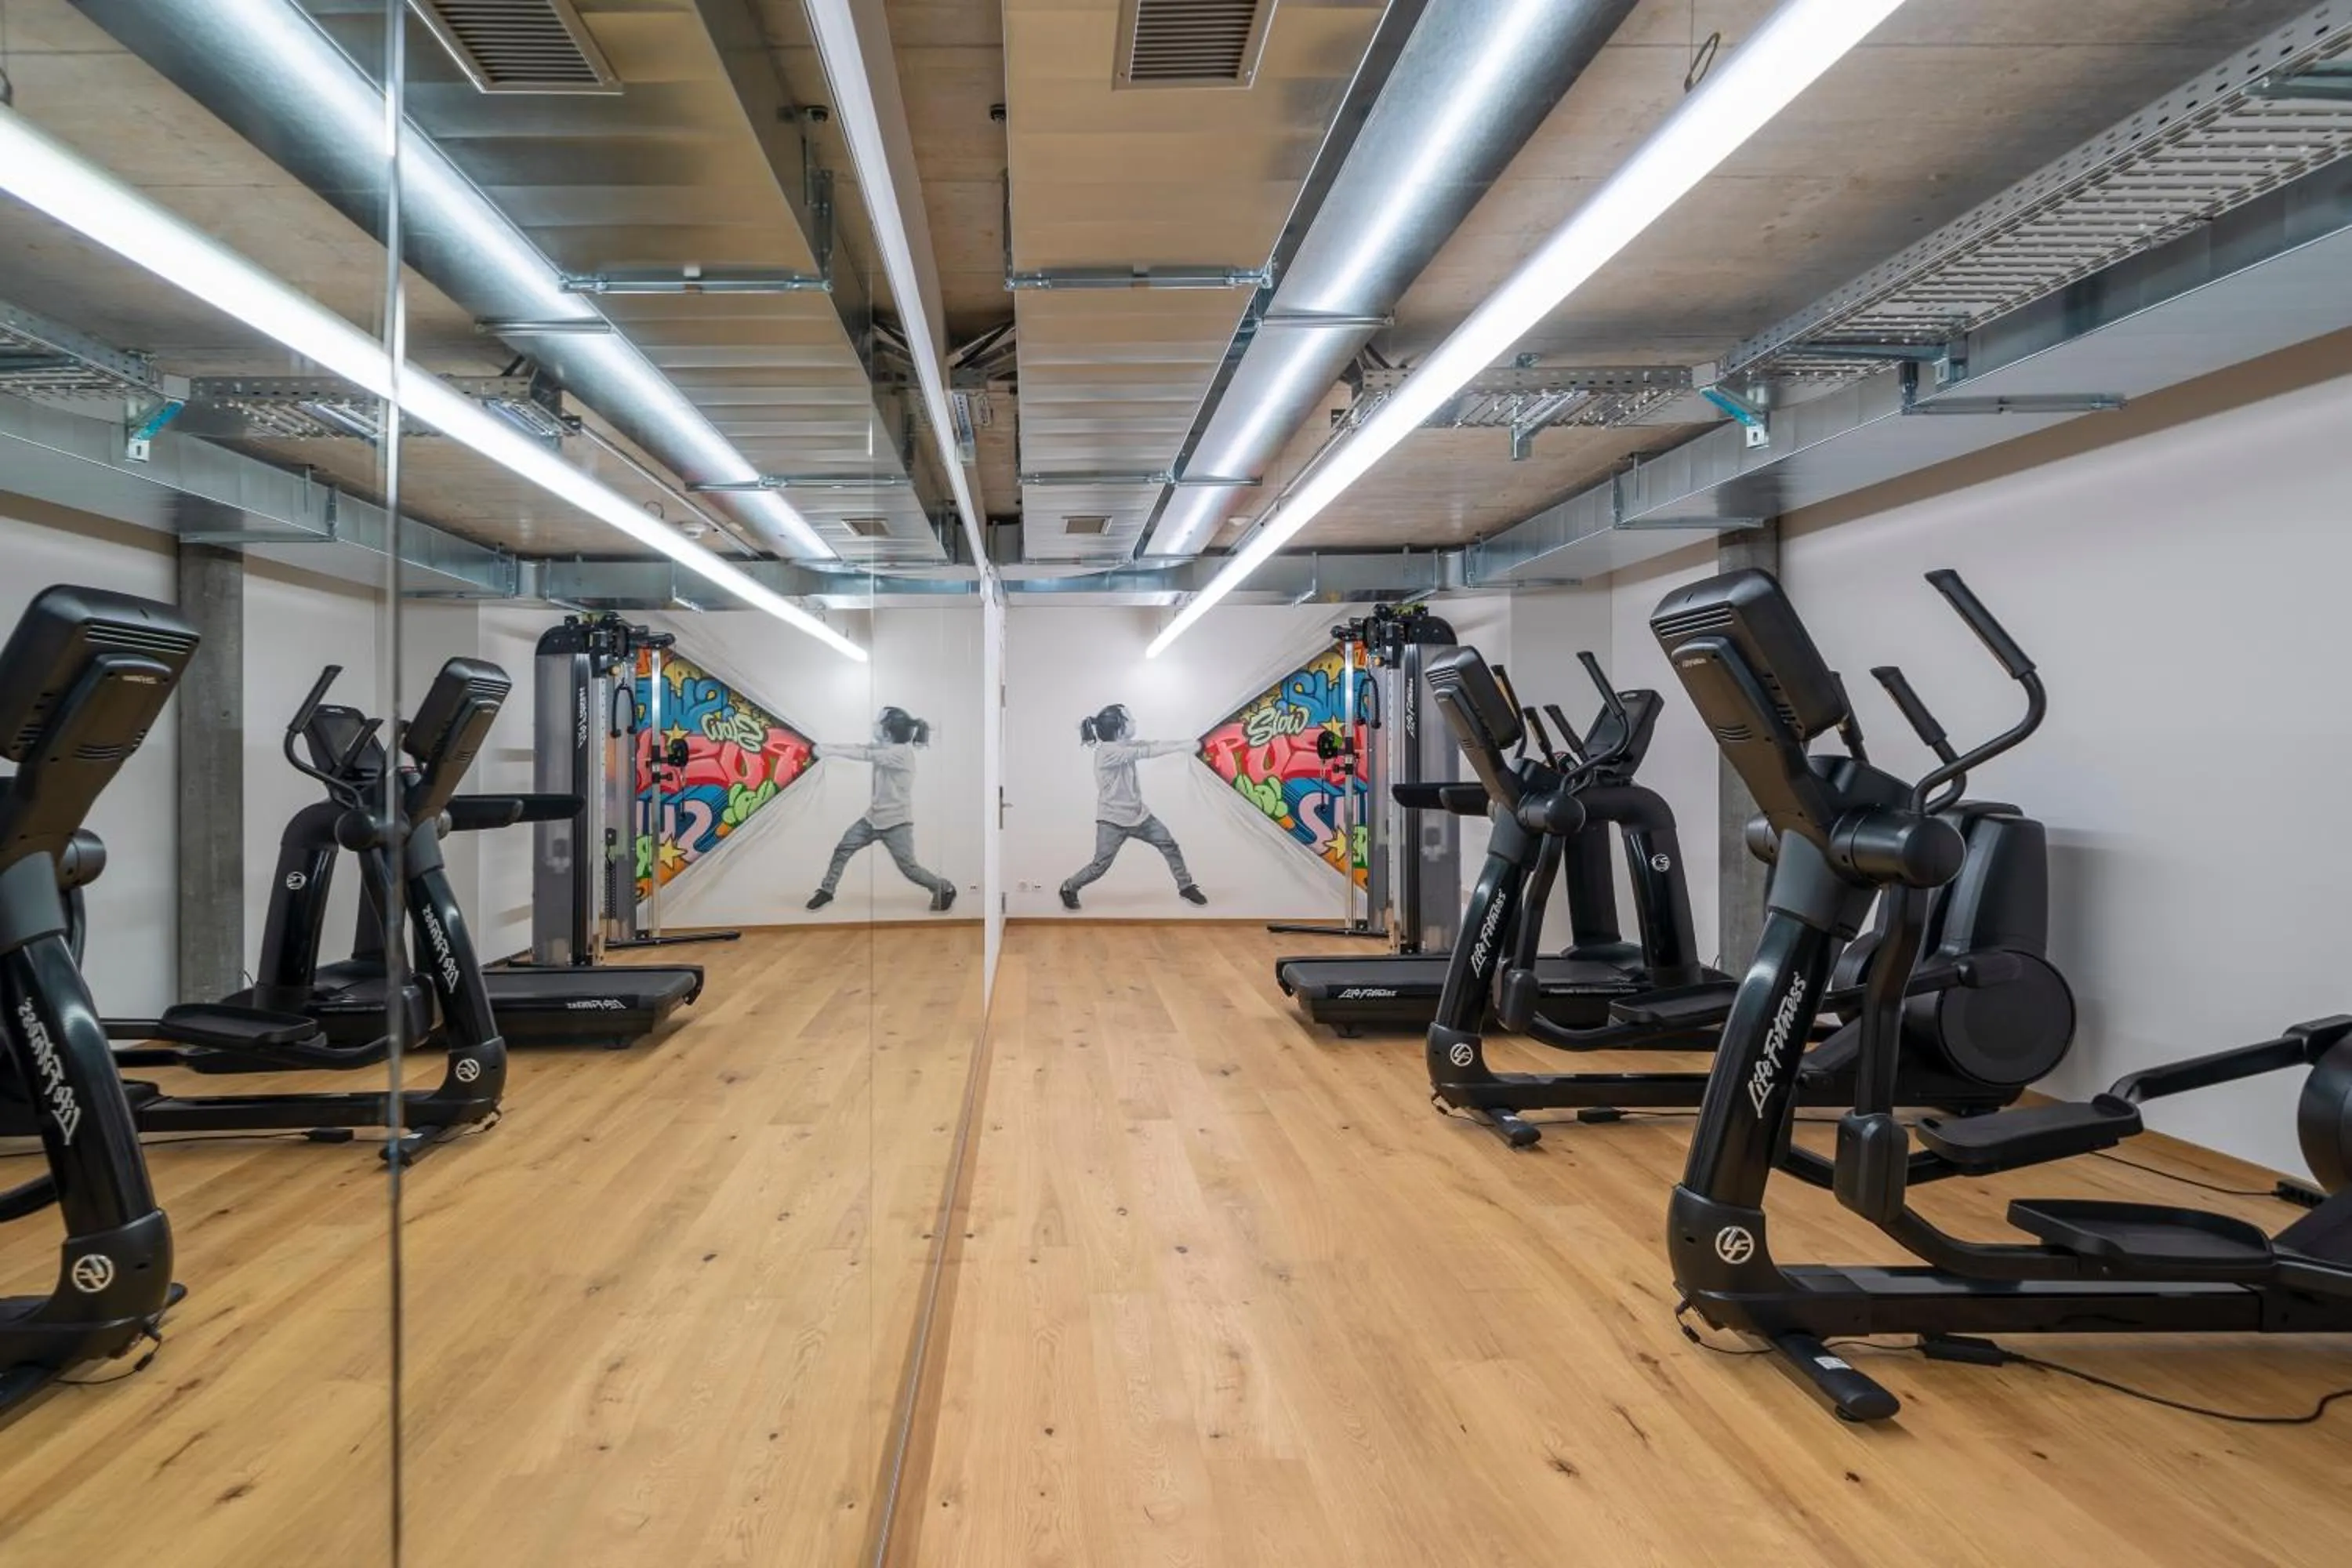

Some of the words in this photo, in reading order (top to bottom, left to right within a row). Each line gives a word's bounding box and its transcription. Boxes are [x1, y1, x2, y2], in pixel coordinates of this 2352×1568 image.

[1247, 706, 1309, 748] Slow
[1747, 1061, 1776, 1120] Life
[1763, 971, 1806, 1069] Fitness
